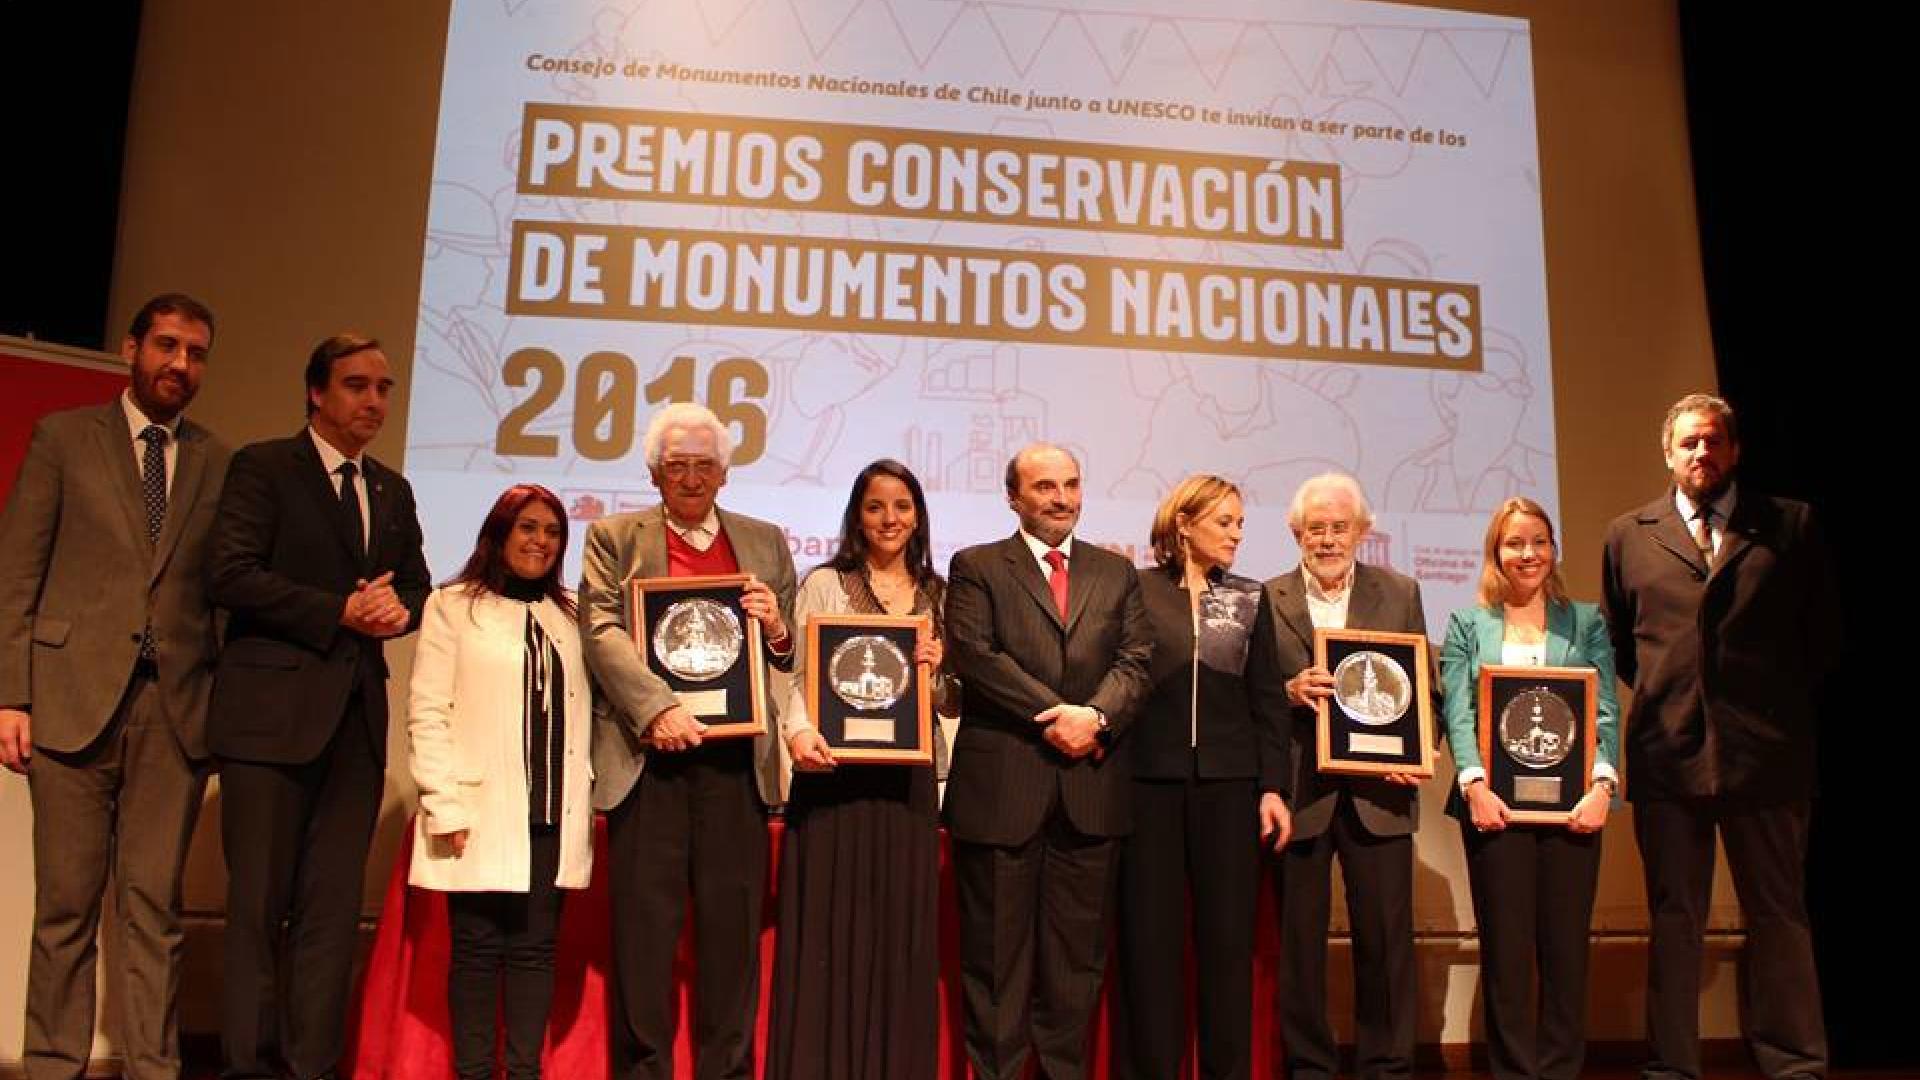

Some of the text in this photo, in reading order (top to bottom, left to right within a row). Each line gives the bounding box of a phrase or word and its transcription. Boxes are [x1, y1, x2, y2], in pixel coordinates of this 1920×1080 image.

[527, 54, 1466, 147] Consejo de Monumentos Nacionales de Chile junto a UNESCO te invitan a ser parte de los
[528, 118, 1335, 240] PREMIOS CONSERVACIÓN
[518, 231, 1473, 358] DE MONUMENTOS NACIONALES
